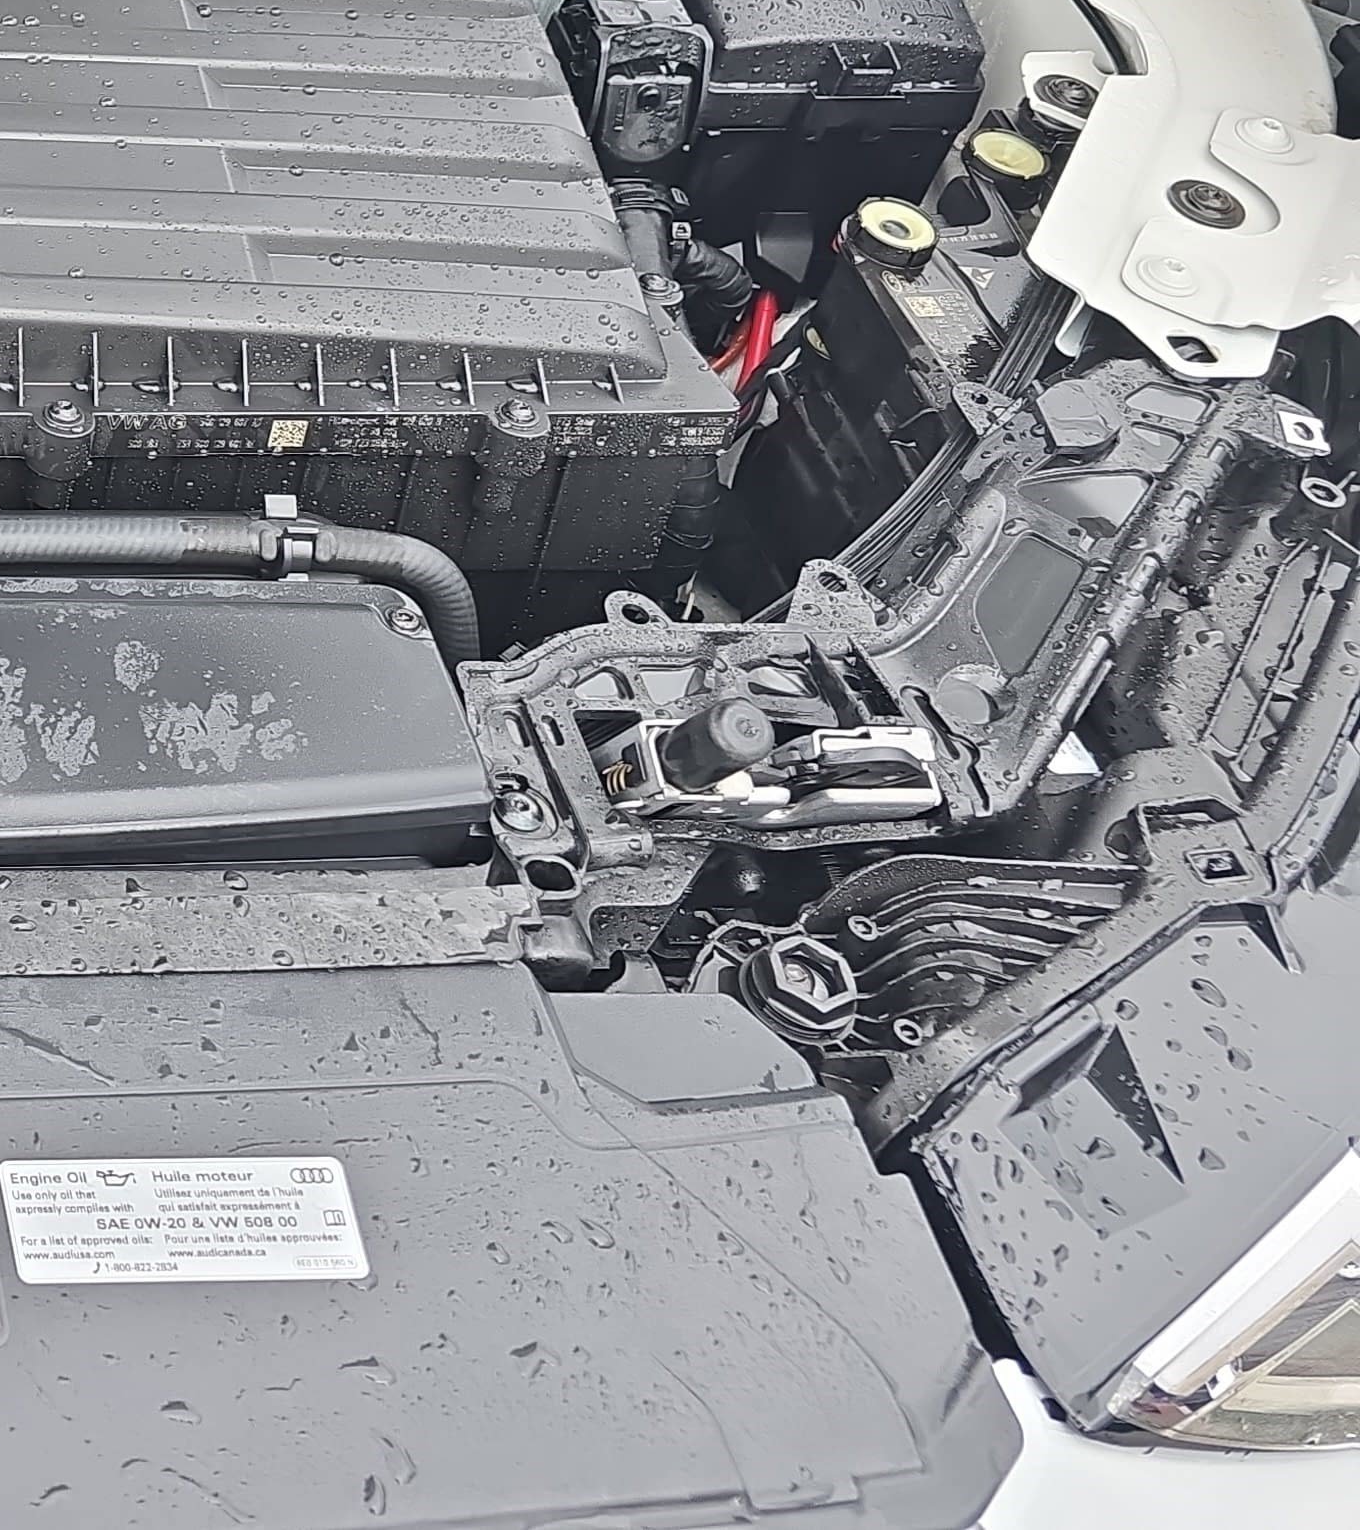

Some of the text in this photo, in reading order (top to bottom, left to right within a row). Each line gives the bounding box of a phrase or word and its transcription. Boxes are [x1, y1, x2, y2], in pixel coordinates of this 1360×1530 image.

[107, 415, 147, 431] VW
[149, 415, 188, 431] AG
[10, 1171, 88, 1187] Engine Oil
[152, 1171, 254, 1183] Huile moteur
[11, 1190, 96, 1201] Use only oil that
[154, 1186, 304, 1199] Utilisez uniquement de l'huile
[15, 1203, 135, 1215] expressly complies with
[158, 1201, 174, 1213] qui
[177, 1201, 217, 1212] satisfait
[294, 1201, 301, 1210] à
[96, 1216, 298, 1230] SAE 0W-20 & VW 508 00
[20, 1234, 153, 1247] For a list of approved oils:
[164, 1234, 188, 1244] Pour
[213, 1233, 235, 1243] liste
[238, 1233, 277, 1243] d'huiles
[23, 1250, 116, 1260] www.audiusa.com
[168, 1248, 267, 1258] www.audicanada.ca
